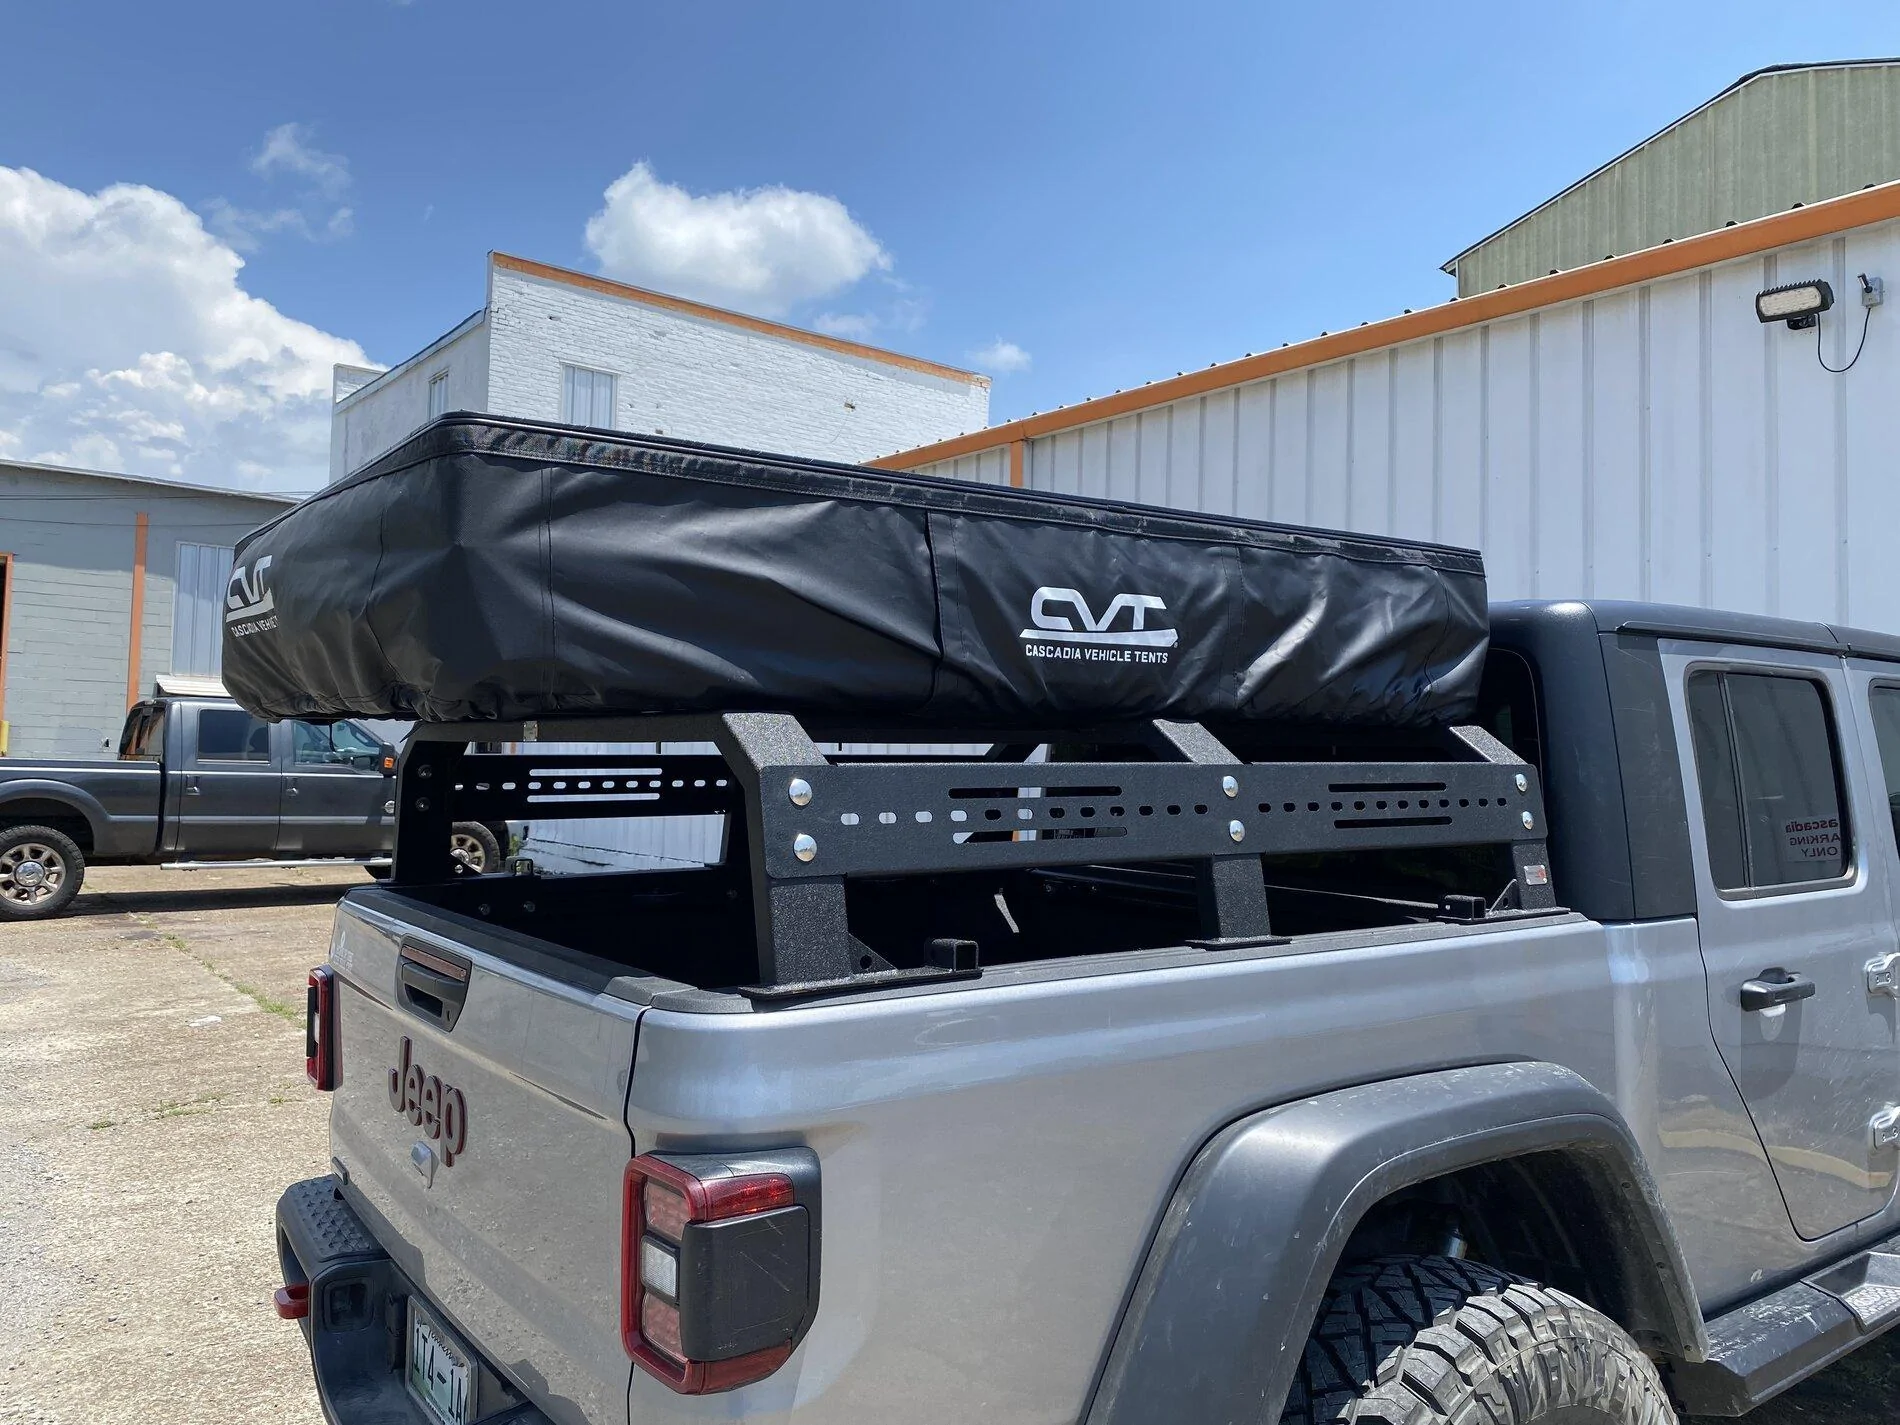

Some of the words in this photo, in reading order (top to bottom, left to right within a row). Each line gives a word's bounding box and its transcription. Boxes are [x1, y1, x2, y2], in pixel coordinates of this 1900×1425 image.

[227, 555, 272, 610] CVT
[1031, 586, 1167, 631] CVT
[1025, 644, 1081, 660] CASCADIA
[1084, 648, 1131, 662] VEHICLE
[1135, 651, 1168, 664] TENTS
[388, 1036, 469, 1168] Jeep
